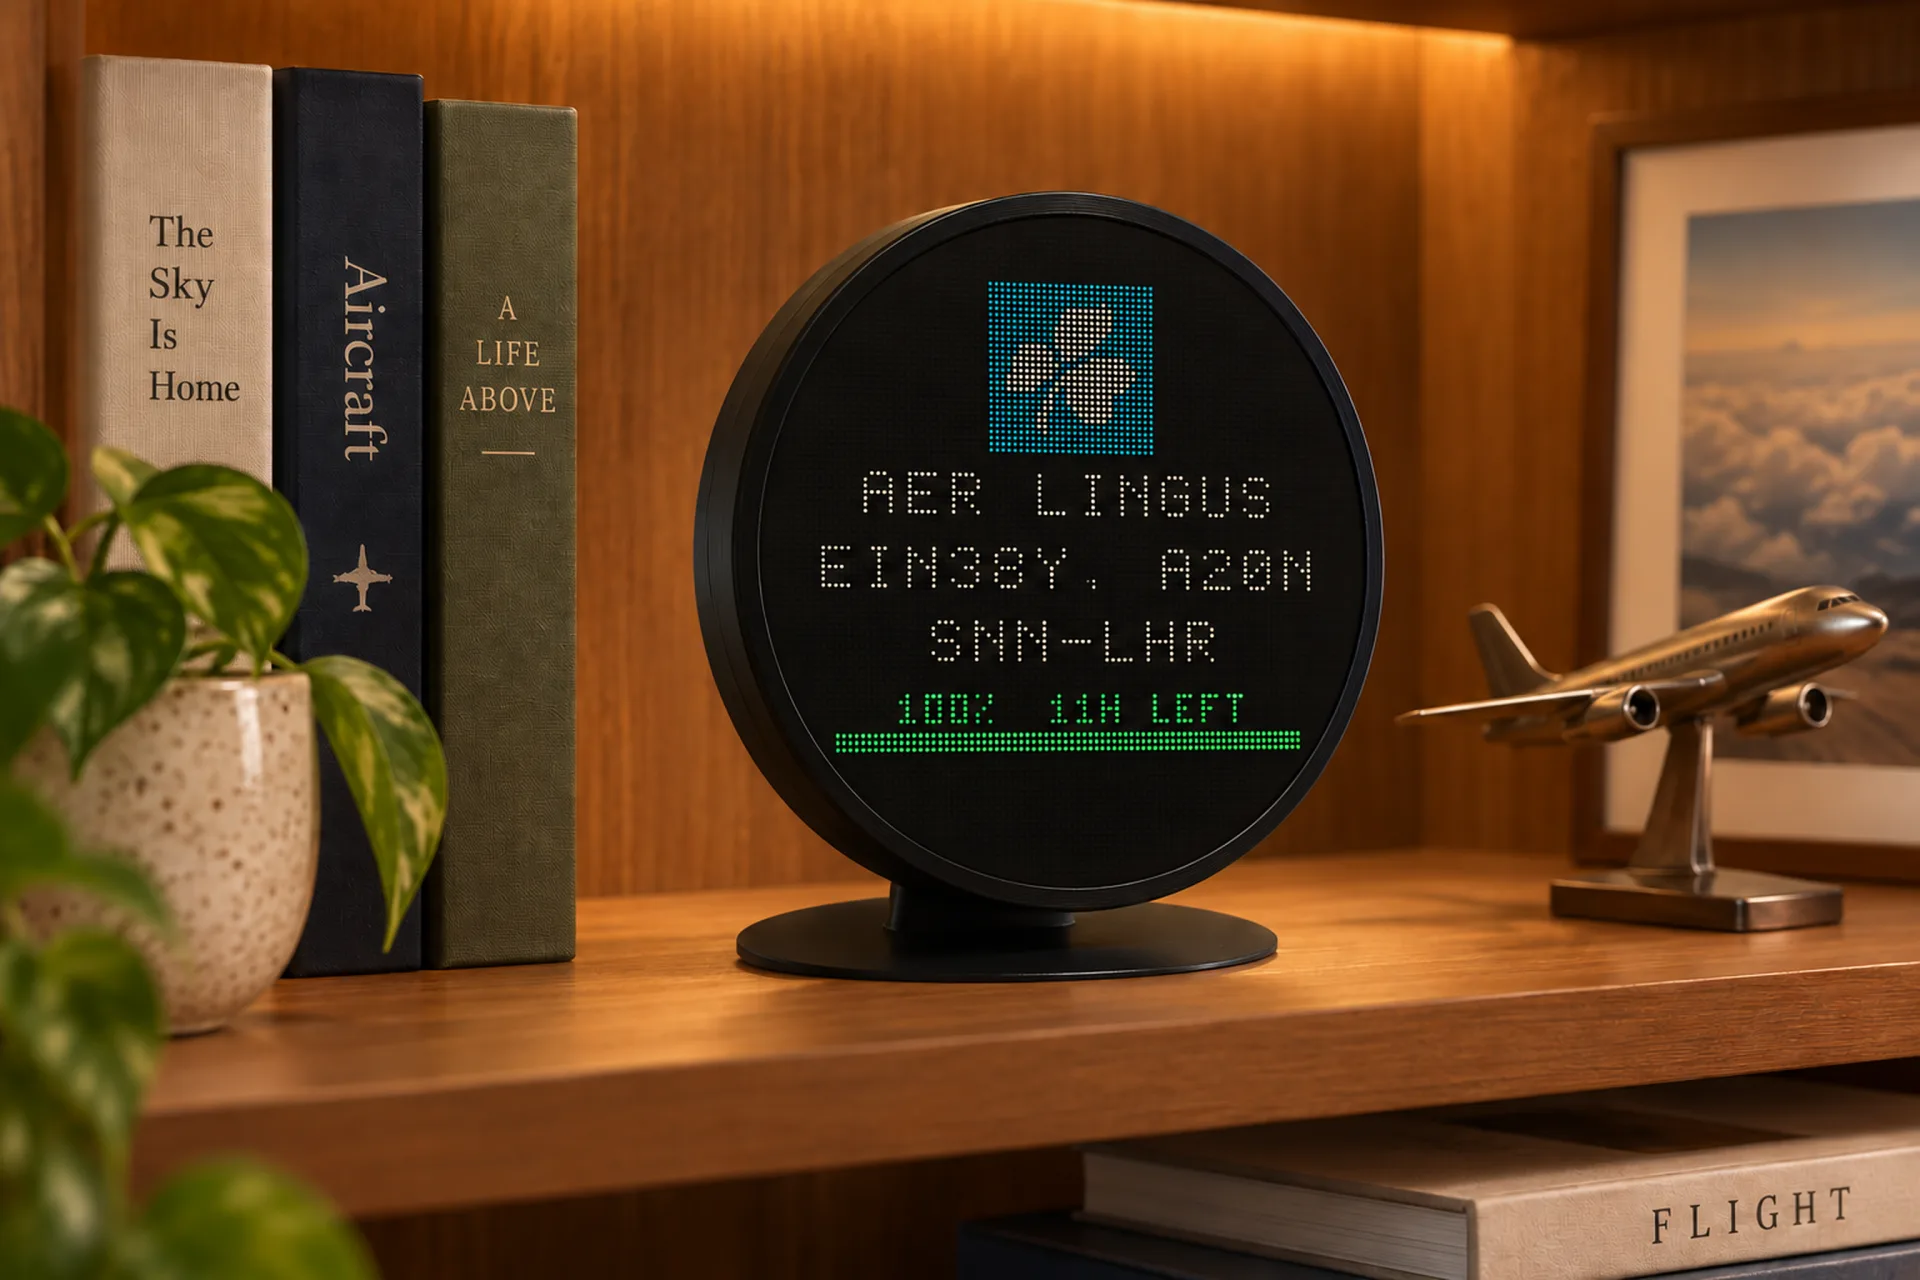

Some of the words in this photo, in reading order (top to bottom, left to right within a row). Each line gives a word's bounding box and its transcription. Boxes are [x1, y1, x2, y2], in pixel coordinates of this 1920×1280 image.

[149, 214, 214, 248] The
[149, 267, 214, 308] Sky
[498, 295, 517, 321] A
[149, 319, 177, 350] Is
[344, 256, 388, 461] Aircraft
[476, 340, 540, 367] LIFE
[149, 371, 240, 402] Home
[459, 386, 556, 413] ABOVE
[862, 470, 981, 515] AER
[1037, 473, 1270, 519] LINGUS
[1161, 548, 1311, 592] A20N
[930, 619, 1215, 663] SNN-LHR
[898, 693, 993, 725] 100%
[1050, 693, 1120, 724] 11H
[1152, 693, 1244, 724] LEFT
[1651, 1186, 1851, 1244] FLIGHT
